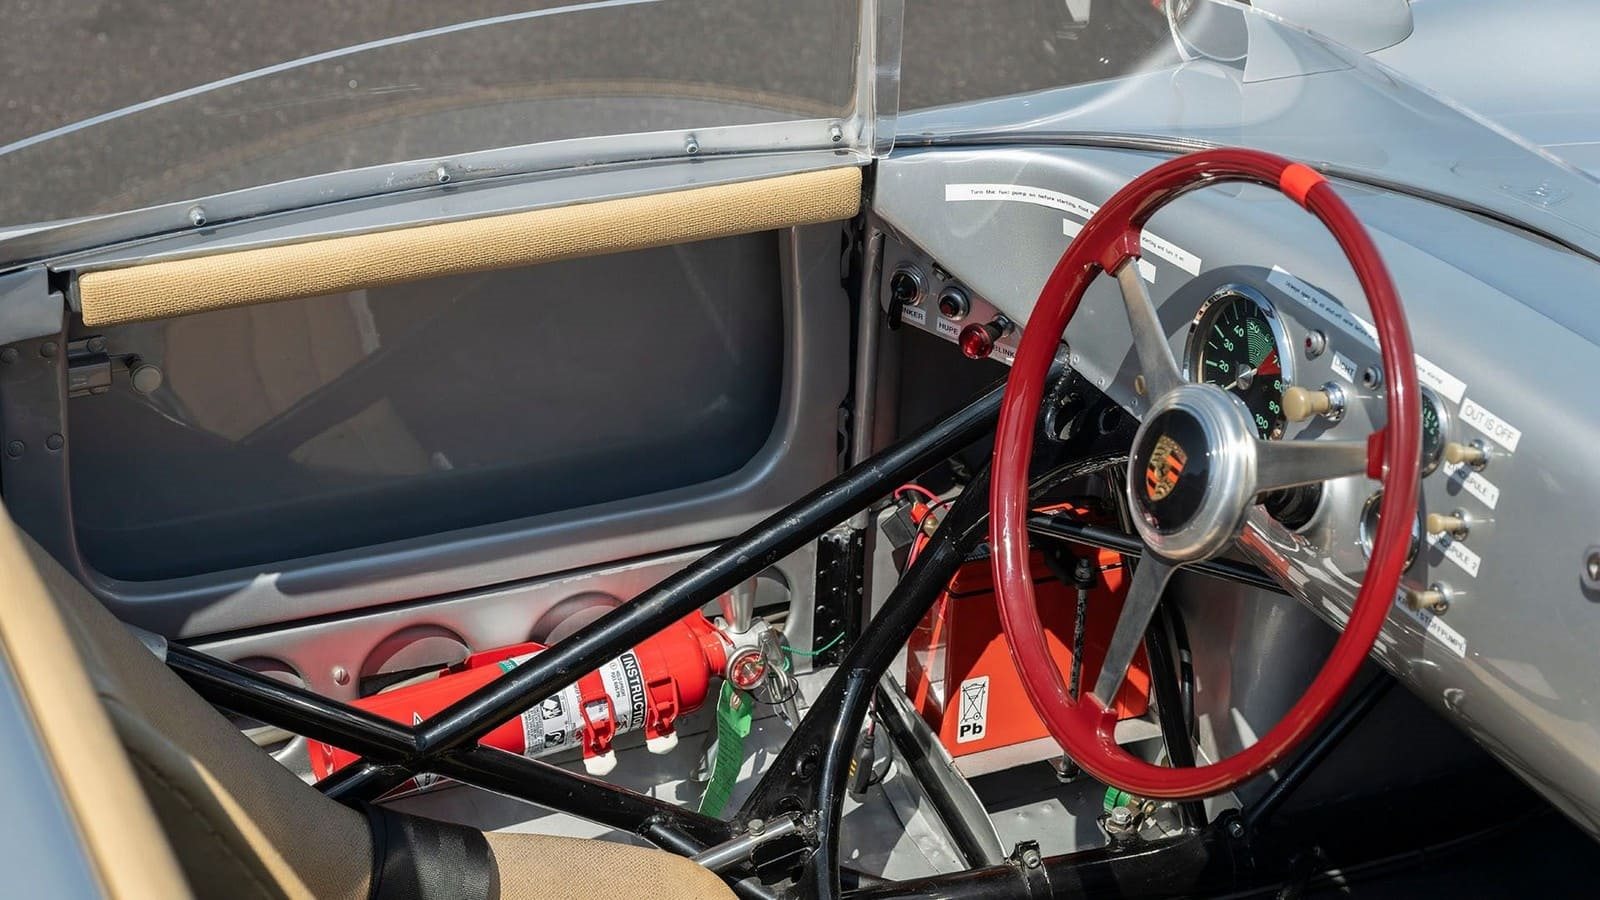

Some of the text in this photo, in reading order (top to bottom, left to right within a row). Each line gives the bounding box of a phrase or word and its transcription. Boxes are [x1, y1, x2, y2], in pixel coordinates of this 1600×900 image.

[903, 307, 924, 321] NKER
[938, 321, 959, 337] HUPE
[1233, 324, 1245, 338] 40
[1223, 338, 1235, 352] 30
[1218, 359, 1230, 374] 20
[1268, 401, 1280, 415] 90
[1254, 413, 1270, 430] 100
[1464, 404, 1515, 442] OUT IS OFF
[959, 723, 983, 738] Pb
